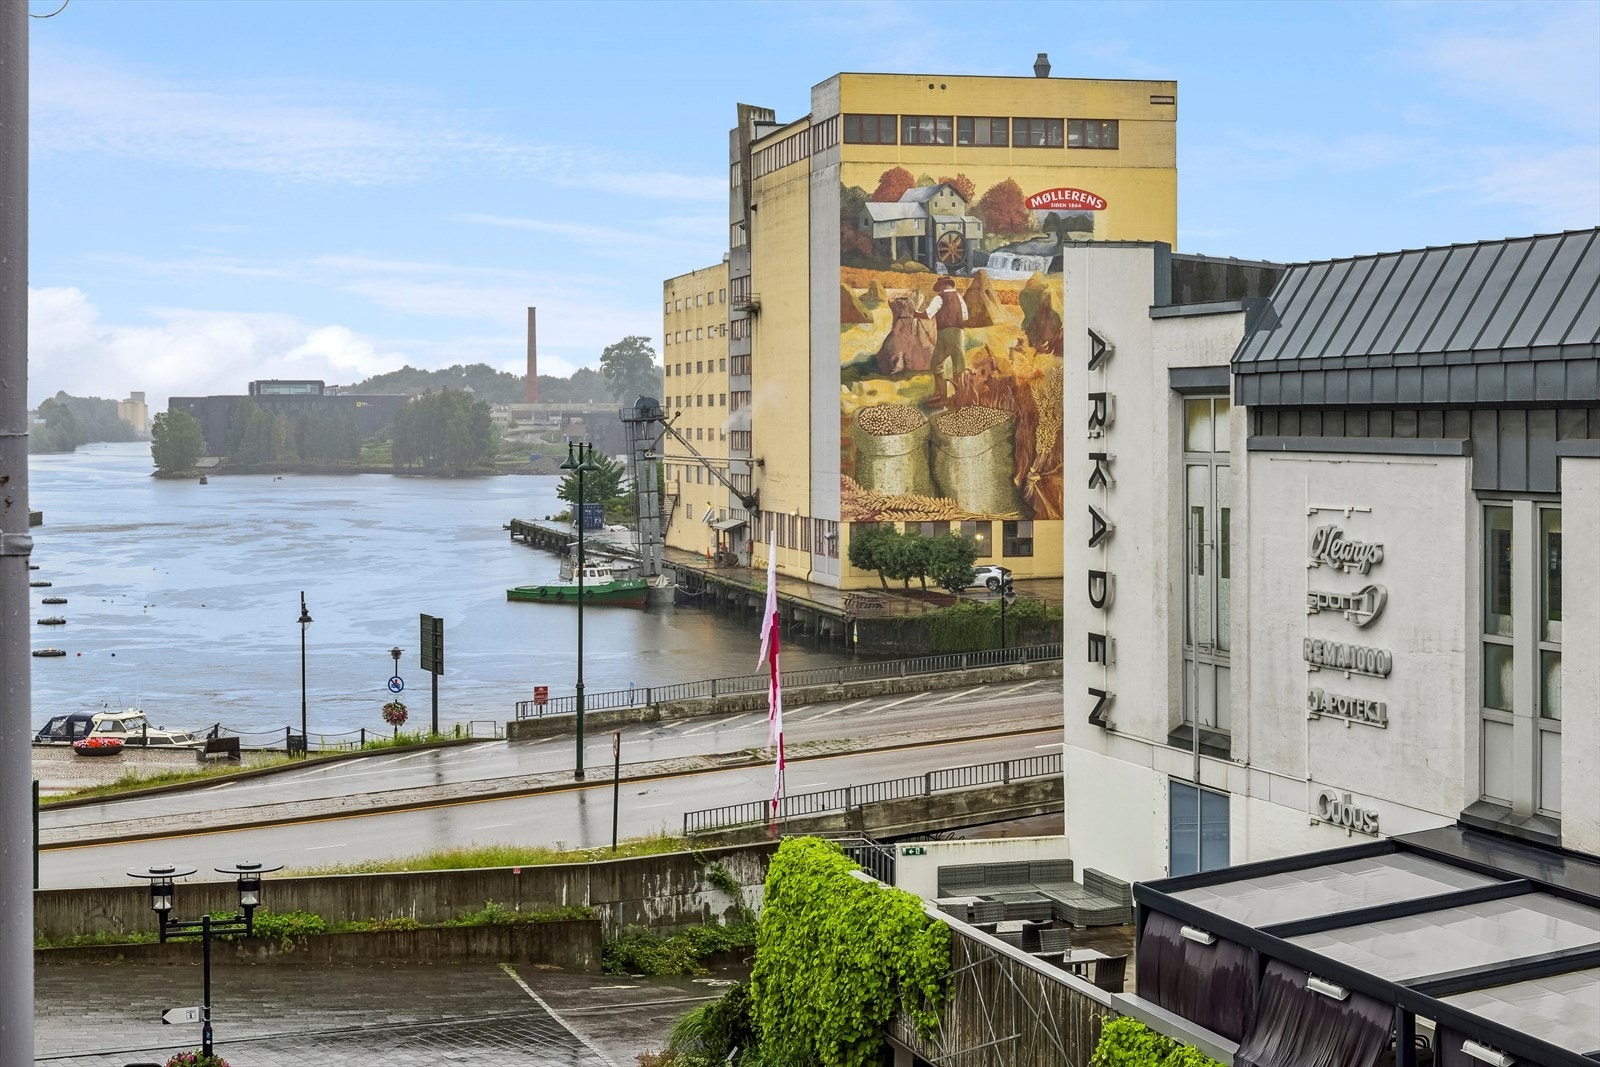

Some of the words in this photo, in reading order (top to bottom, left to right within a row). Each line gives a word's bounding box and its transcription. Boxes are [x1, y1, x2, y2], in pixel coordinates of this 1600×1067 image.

[1030, 190, 1104, 209] MØLLERENS
[1087, 327, 1112, 729] ARKADEN
[1303, 638, 1348, 669] REMA
[1349, 645, 1392, 676] 1000
[1319, 692, 1376, 721] APOTEK
[1318, 789, 1379, 833] Cubus
